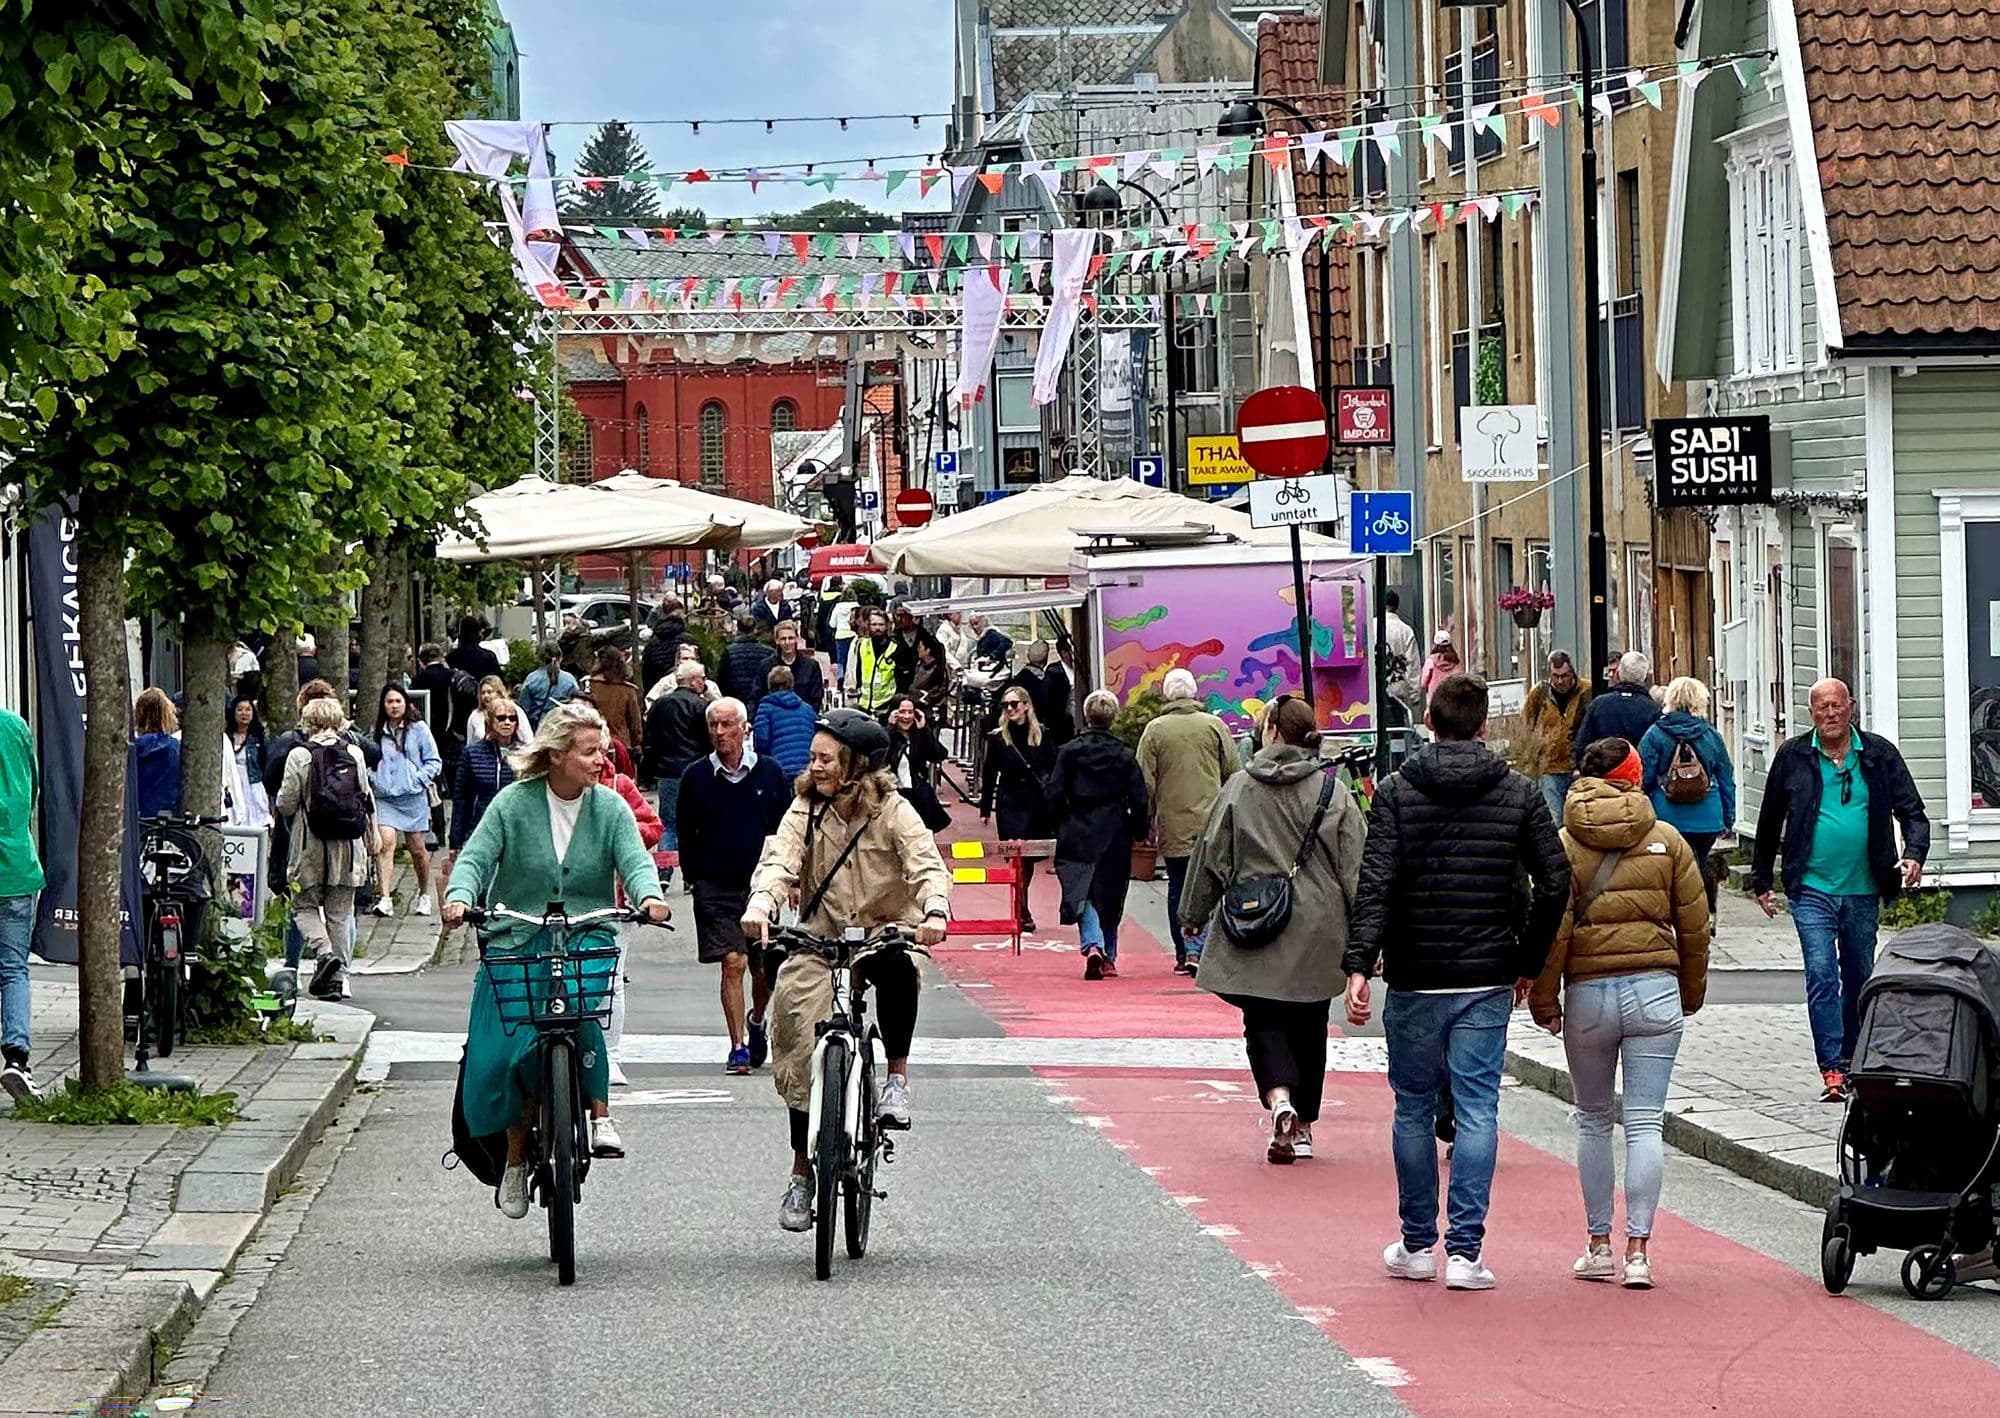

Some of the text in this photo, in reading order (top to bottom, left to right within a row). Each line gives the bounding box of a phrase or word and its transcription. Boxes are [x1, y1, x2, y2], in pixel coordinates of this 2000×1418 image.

[1343, 429, 1386, 439] IMPORT
[1670, 426, 1740, 455] SABI
[940, 454, 952, 470] P
[1139, 460, 1156, 485] P
[1192, 465, 1250, 475] TAKE AWAY
[1466, 466, 1534, 478] SKOGENS HUS
[1671, 455, 1758, 484] SUSHI
[1672, 486, 1758, 497] TAKE AWAY
[864, 493, 874, 507] P
[1271, 507, 1318, 522] unntatt
